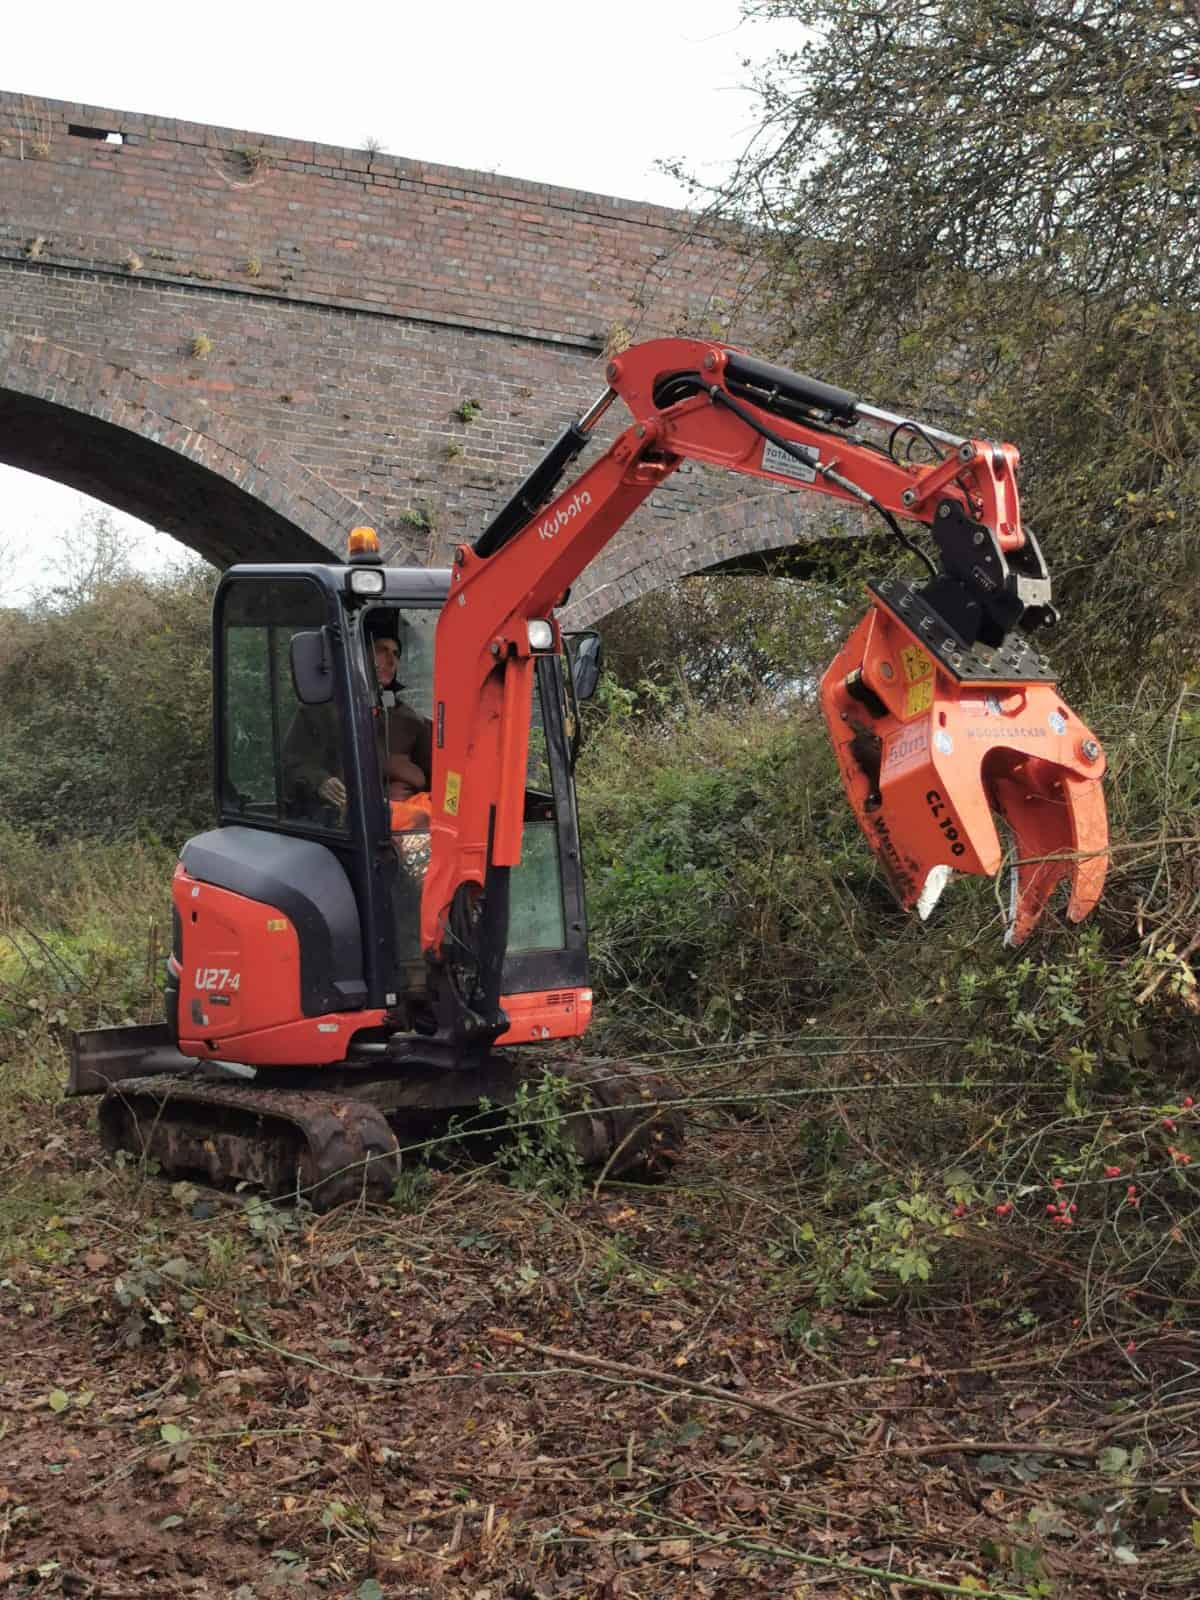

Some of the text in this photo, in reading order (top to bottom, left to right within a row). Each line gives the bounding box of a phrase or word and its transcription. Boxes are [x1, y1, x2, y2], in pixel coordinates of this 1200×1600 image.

[538, 491, 592, 539] Kubota
[926, 790, 966, 857] CL 190
[194, 968, 241, 992] U27-4
